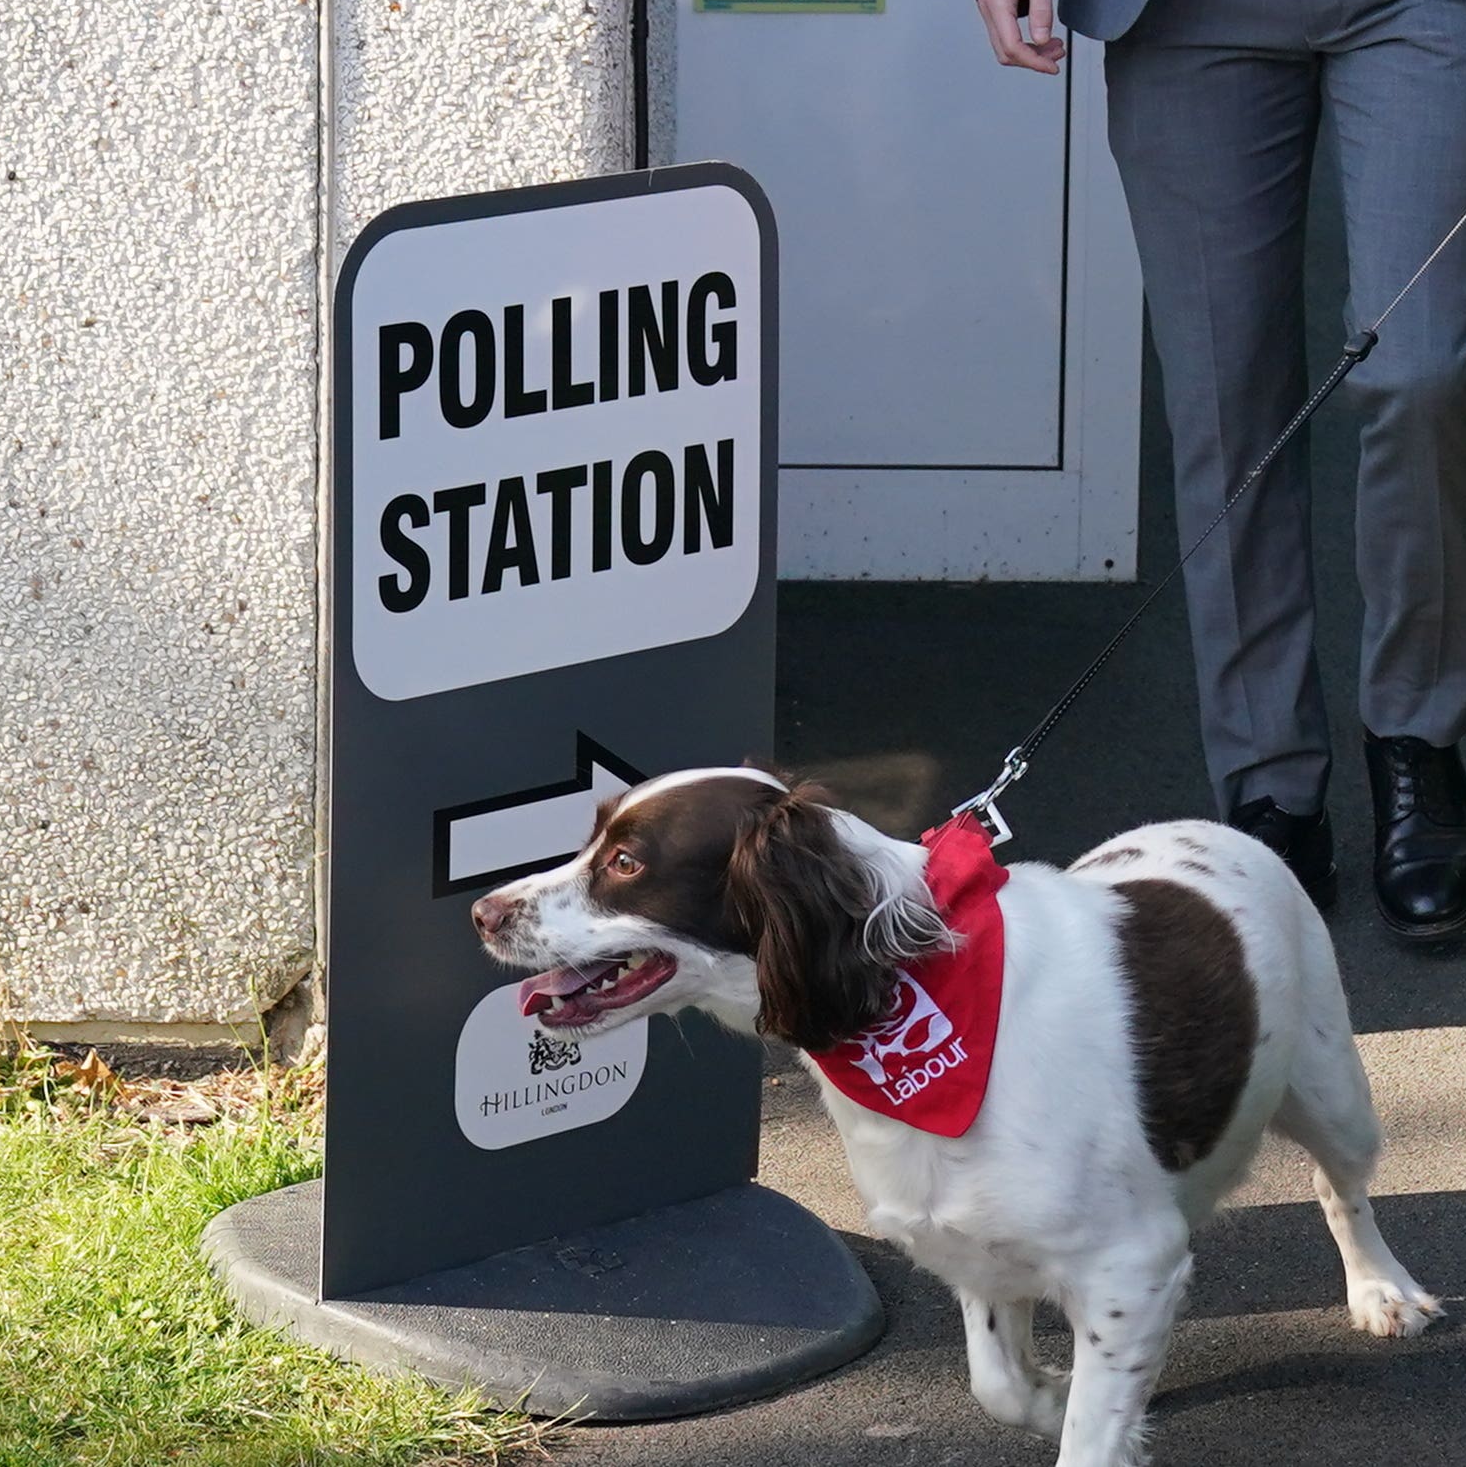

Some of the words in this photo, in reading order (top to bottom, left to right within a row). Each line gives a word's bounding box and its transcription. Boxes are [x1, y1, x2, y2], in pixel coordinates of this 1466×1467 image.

[379, 271, 738, 441] POLLING
[378, 438, 734, 613] STATION
[479, 1061, 628, 1117] HILLINGDON
[881, 1036, 969, 1107] Labour
